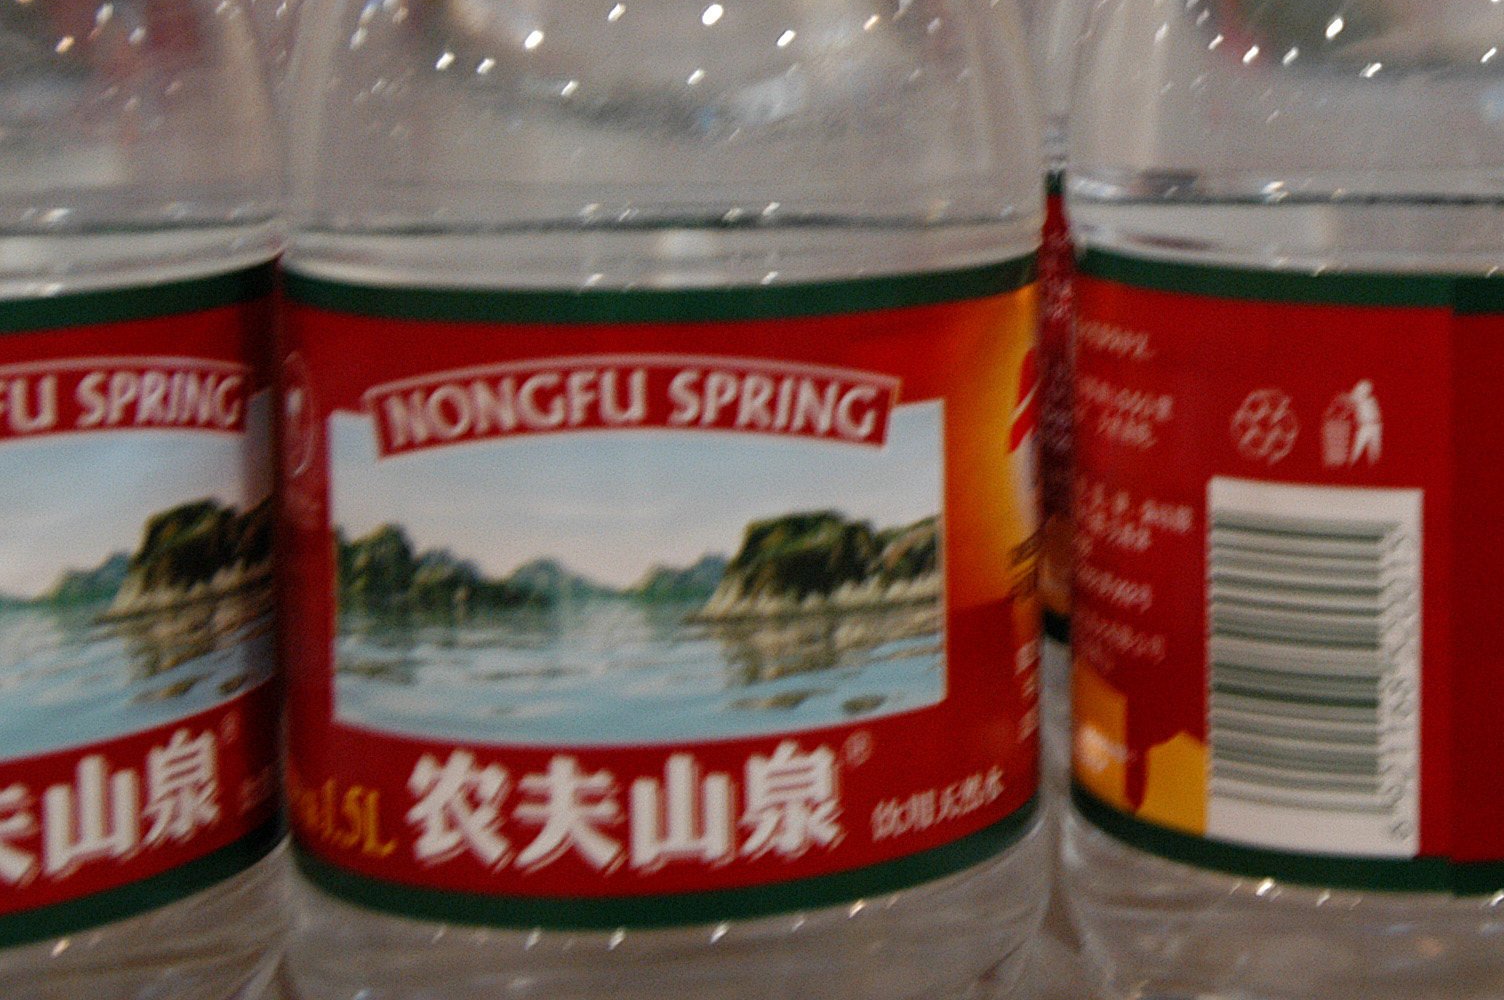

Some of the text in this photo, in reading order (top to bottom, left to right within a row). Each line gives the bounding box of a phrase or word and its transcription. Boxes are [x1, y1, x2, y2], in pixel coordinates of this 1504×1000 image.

[74, 370, 243, 427] SPRING
[385, 368, 648, 447] NONGFU
[667, 368, 878, 439] SPRING
[404, 738, 847, 876] 农夫山泉
